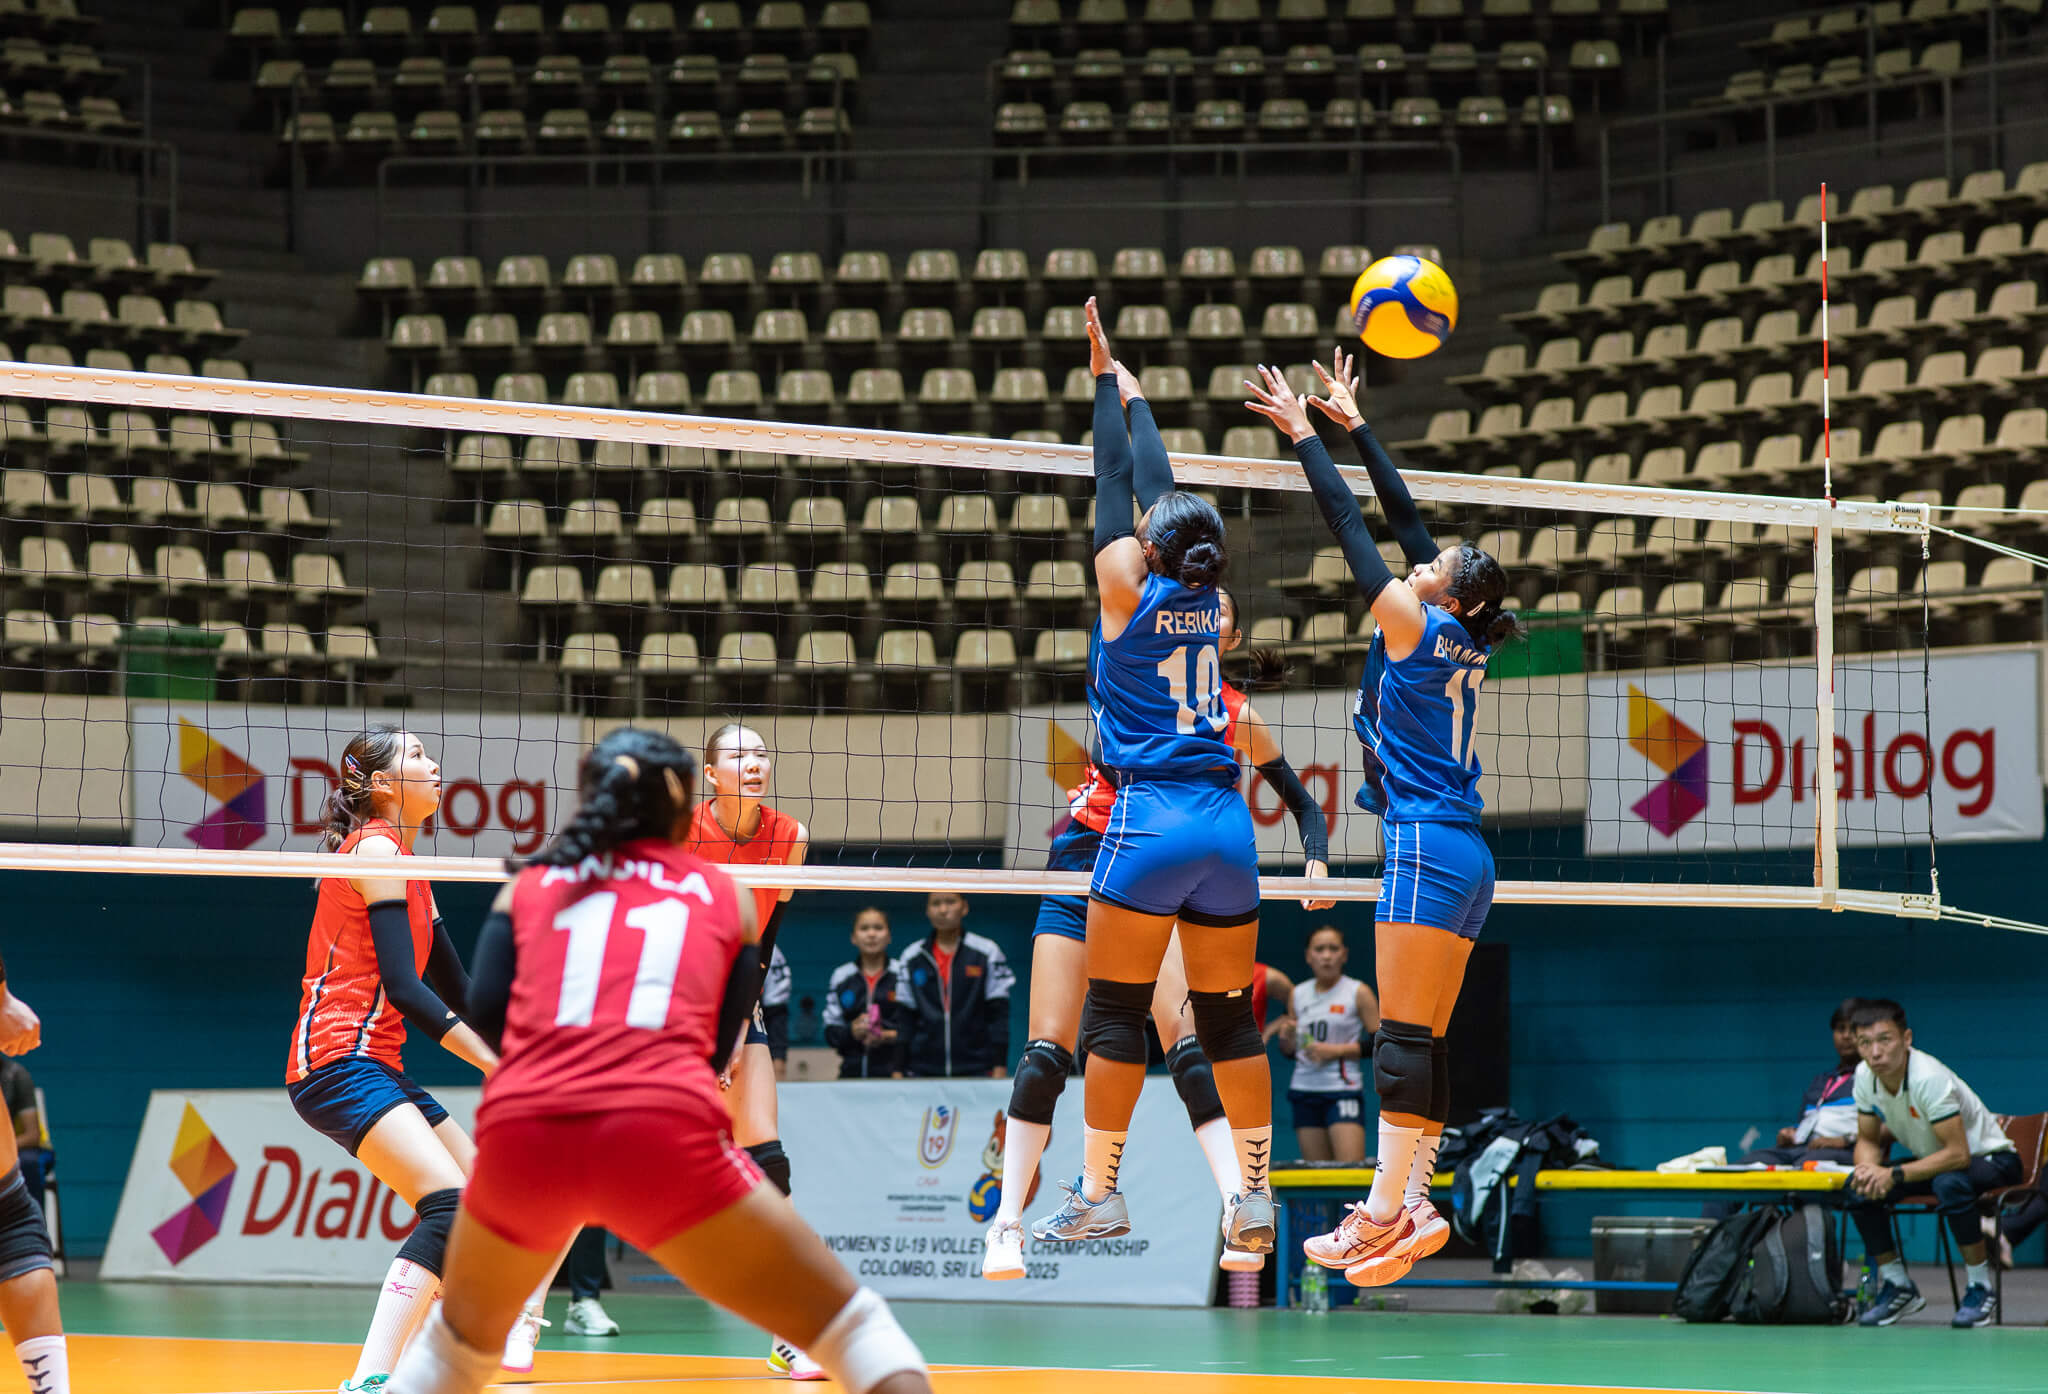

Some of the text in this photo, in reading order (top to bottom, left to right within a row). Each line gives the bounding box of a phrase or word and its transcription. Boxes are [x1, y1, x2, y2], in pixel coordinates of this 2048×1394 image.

[1155, 608, 1219, 634] REBIKA
[1157, 644, 1230, 734] 10
[1731, 710, 1995, 818] Dialog
[540, 852, 714, 905] ANJILA
[552, 890, 690, 1030] 11
[1309, 1020, 1328, 1042] 10
[240, 1146, 421, 1243] Dialo
[895, 1236, 928, 1254] U-19
[1031, 1239, 1149, 1257] CHAMPIONSHIP
[942, 1260, 968, 1278] SRI
[1026, 1262, 1060, 1279] 2025
